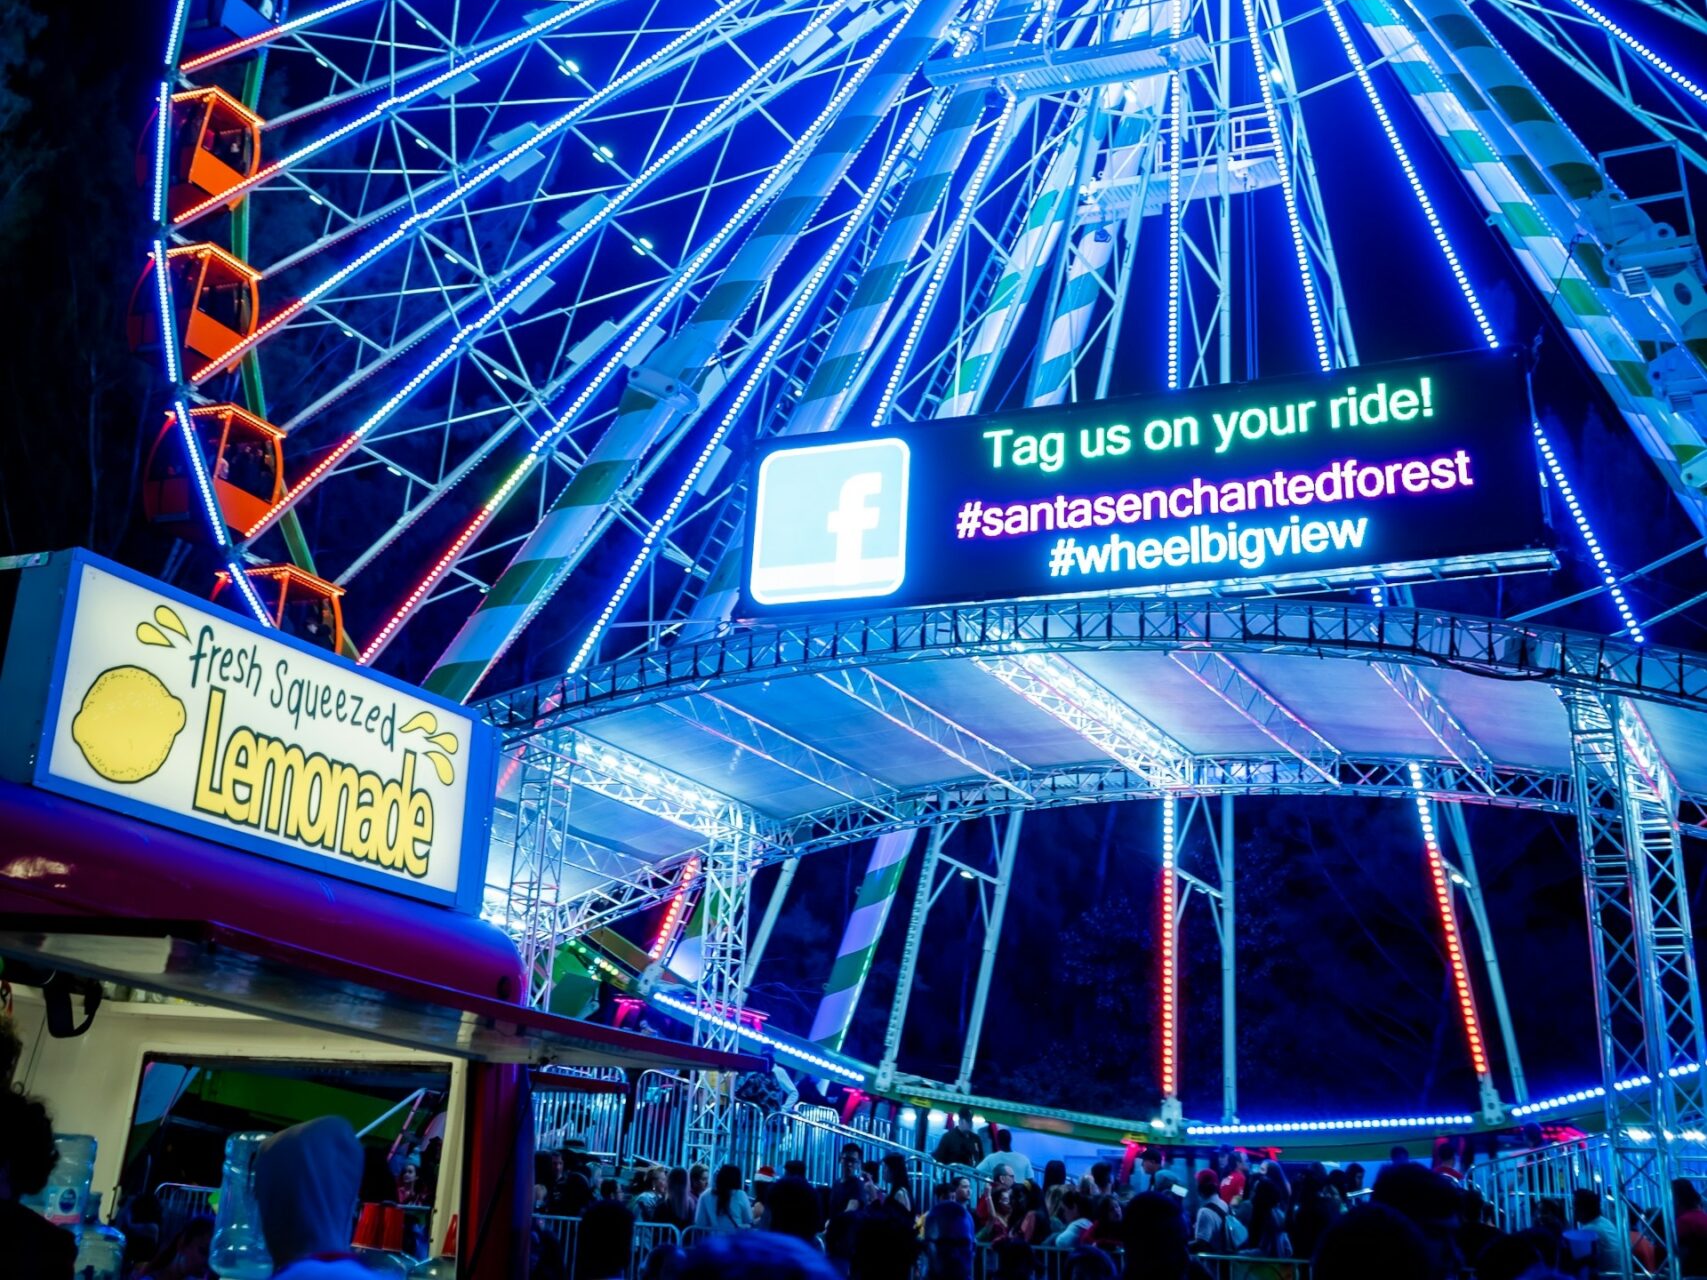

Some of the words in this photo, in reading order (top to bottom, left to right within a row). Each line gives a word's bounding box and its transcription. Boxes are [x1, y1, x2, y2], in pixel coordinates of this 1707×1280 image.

[983, 429, 1065, 472] Tag
[1080, 425, 1132, 459] us
[1143, 416, 1200, 451] on
[1212, 400, 1317, 454] your
[1330, 377, 1434, 429] ride!
[826, 471, 882, 586] f
[956, 450, 1474, 539] #santasenchantedforest
[1048, 515, 1369, 577] #wheelbigview
[189, 624, 263, 698] fresh
[270, 658, 397, 752] Squeezed
[192, 684, 434, 878] Lemonade
